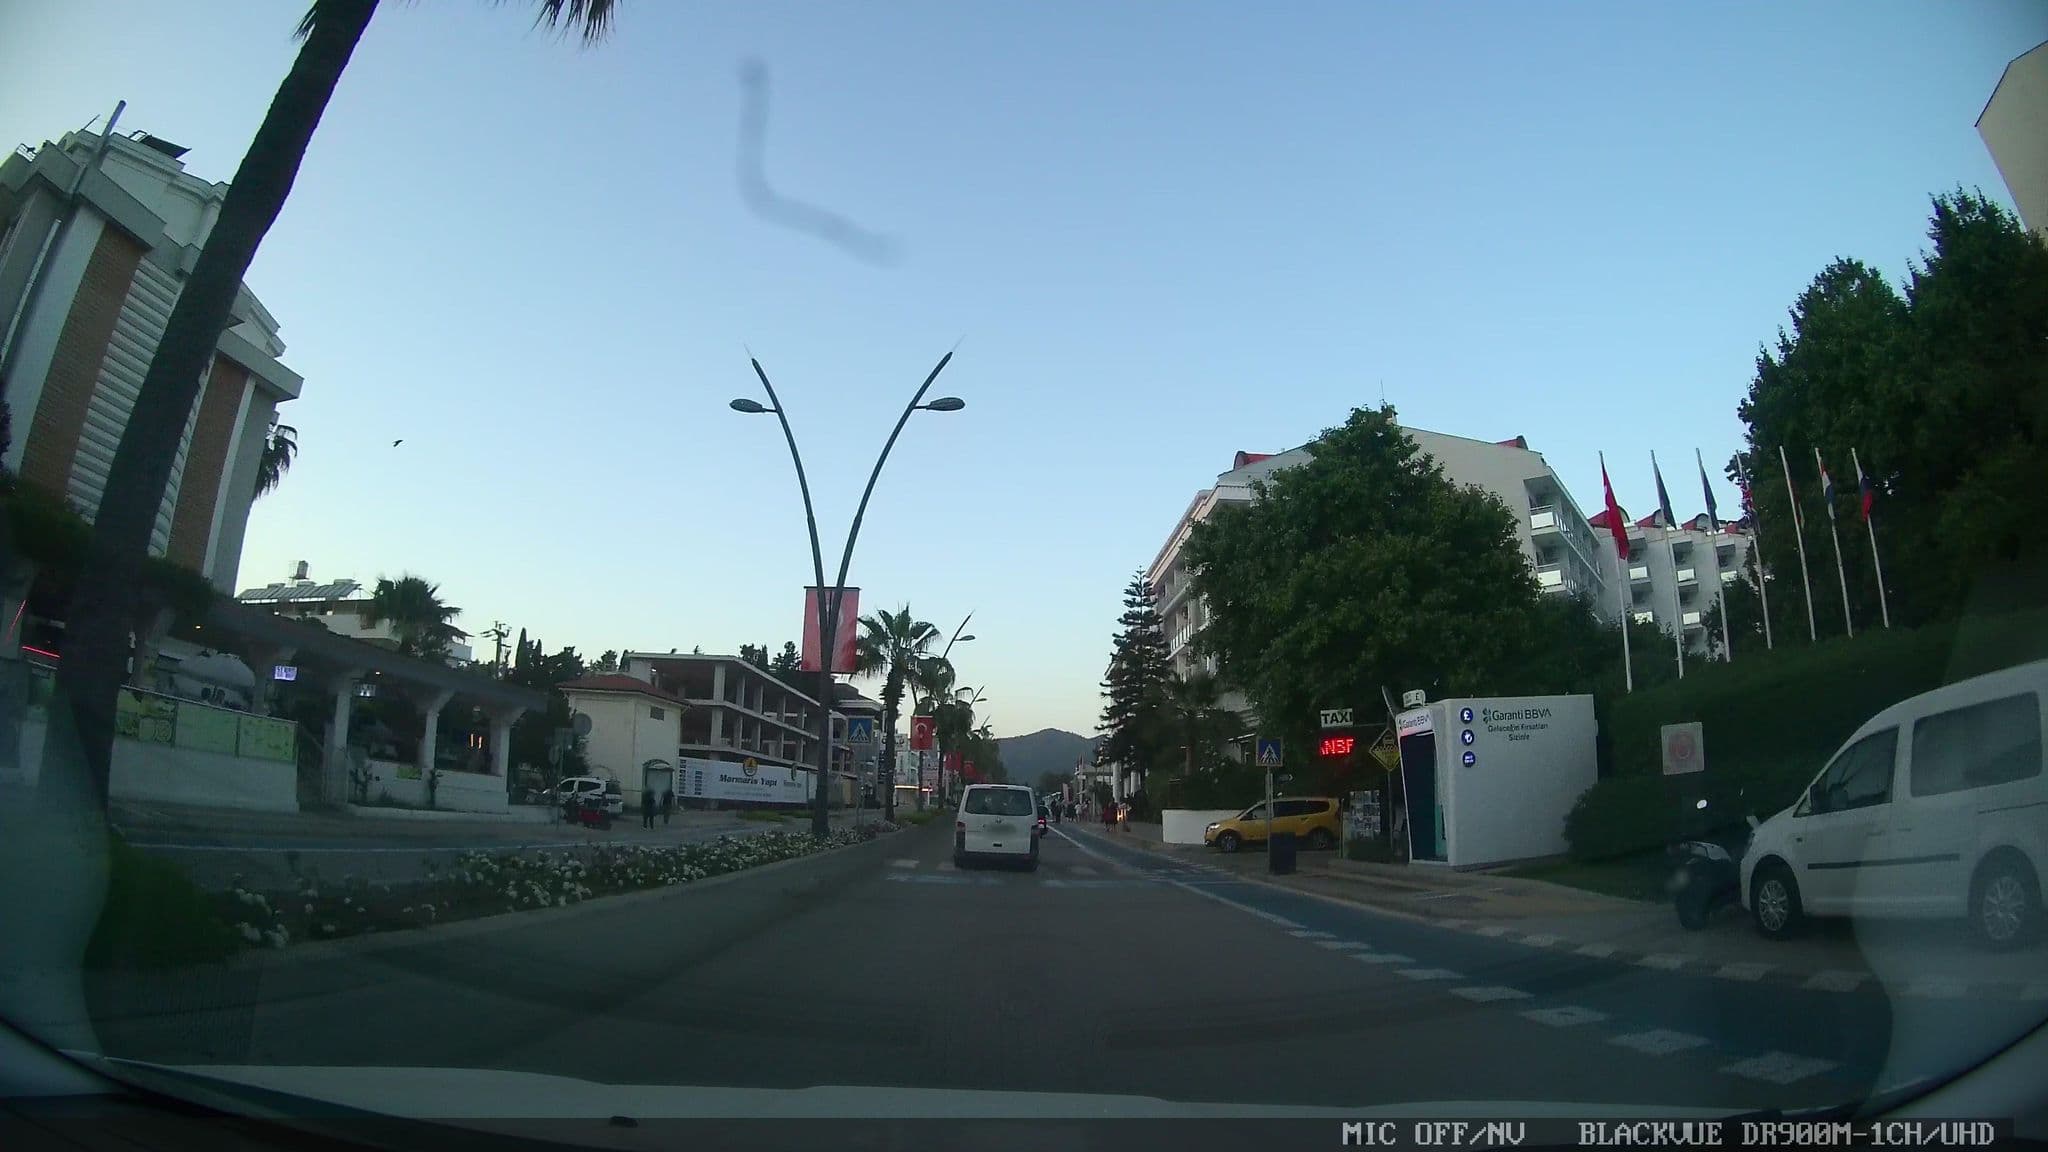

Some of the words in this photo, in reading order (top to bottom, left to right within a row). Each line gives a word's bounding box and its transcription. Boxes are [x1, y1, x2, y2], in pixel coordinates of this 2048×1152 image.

[1321, 712, 1352, 724] TAXI
[1492, 709, 1523, 721] Garanti
[1524, 708, 1552, 720] BBVA
[719, 774, 758, 786] Marmaris
